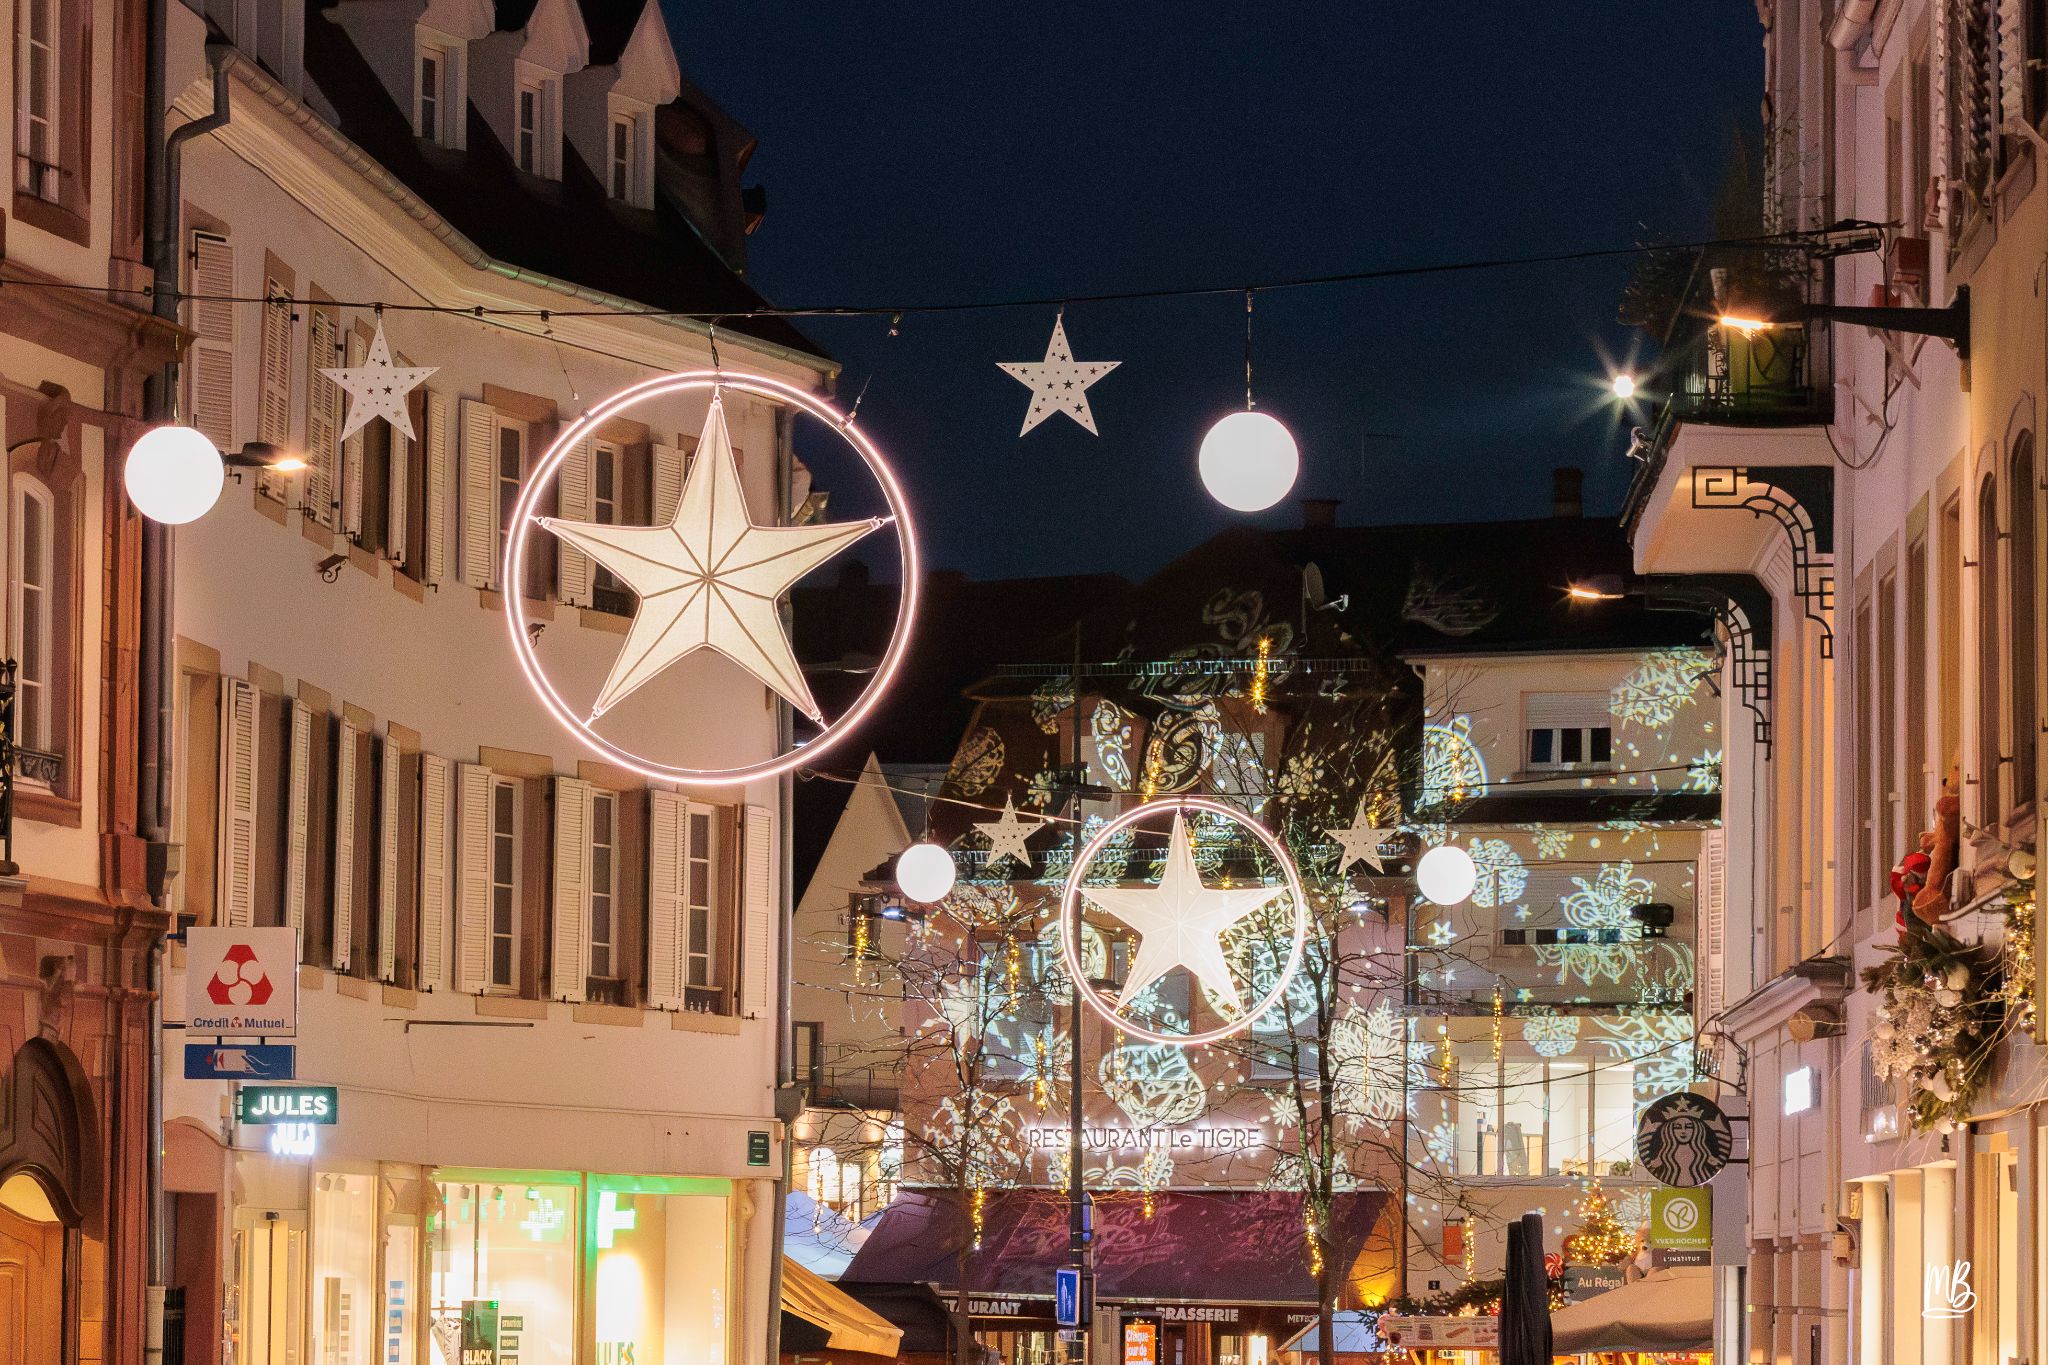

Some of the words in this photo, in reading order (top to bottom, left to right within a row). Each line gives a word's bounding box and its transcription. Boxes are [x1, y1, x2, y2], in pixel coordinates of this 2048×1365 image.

[193, 1017, 229, 1028] Crédit
[244, 1018, 285, 1028] Mutuel
[251, 1095, 328, 1115] JULES
[1170, 1128, 1192, 1148] Le
[1198, 1128, 1262, 1148] TIGRE
[1655, 1237, 1674, 1245] YVES
[1676, 1237, 1707, 1245] ROCHER
[1663, 1255, 1701, 1263] L'INSTITUT
[1577, 1277, 1593, 1288] Au
[1594, 1276, 1625, 1290] Régal
[463, 1349, 493, 1365] BLACK
